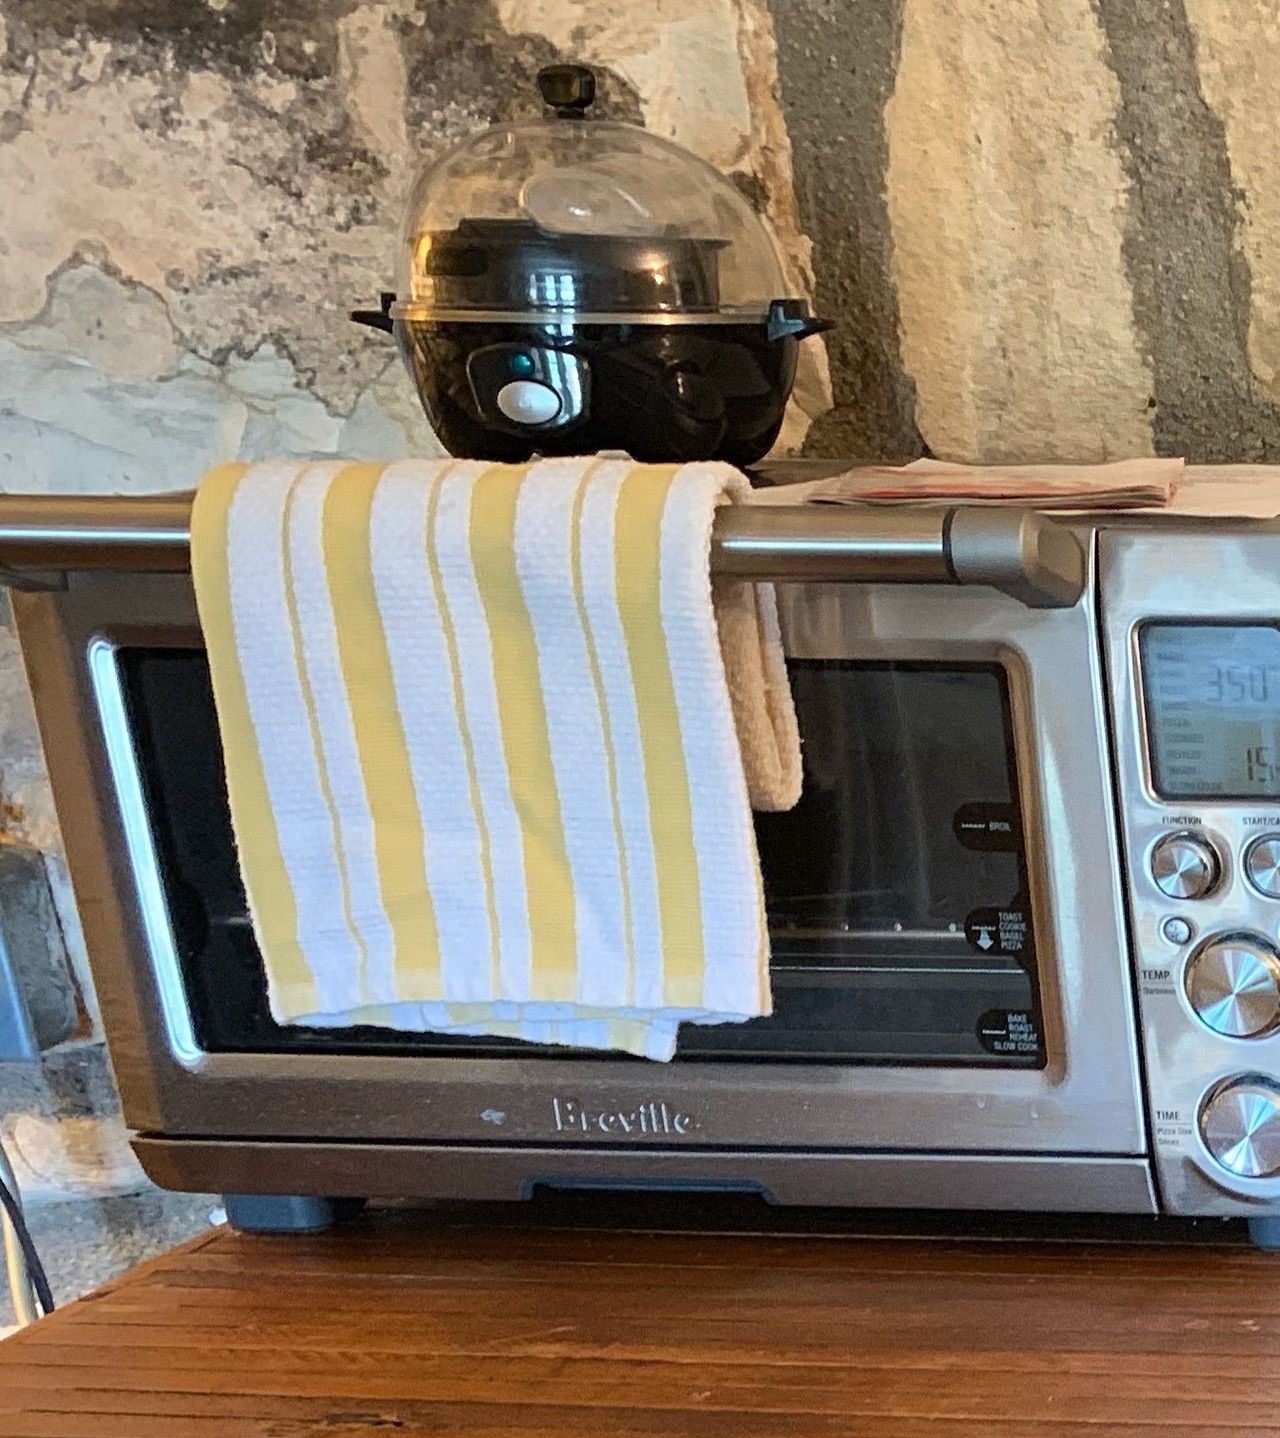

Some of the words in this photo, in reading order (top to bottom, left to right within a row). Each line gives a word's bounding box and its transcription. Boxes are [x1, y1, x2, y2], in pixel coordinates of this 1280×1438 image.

[1246, 746, 1276, 783] 15
[1162, 816, 1202, 825] FUNCTION
[999, 912, 1023, 921] TOAST
[1142, 970, 1170, 980] TEMP
[1008, 1023, 1034, 1033] ROAST
[1156, 1111, 1180, 1120] TIME
